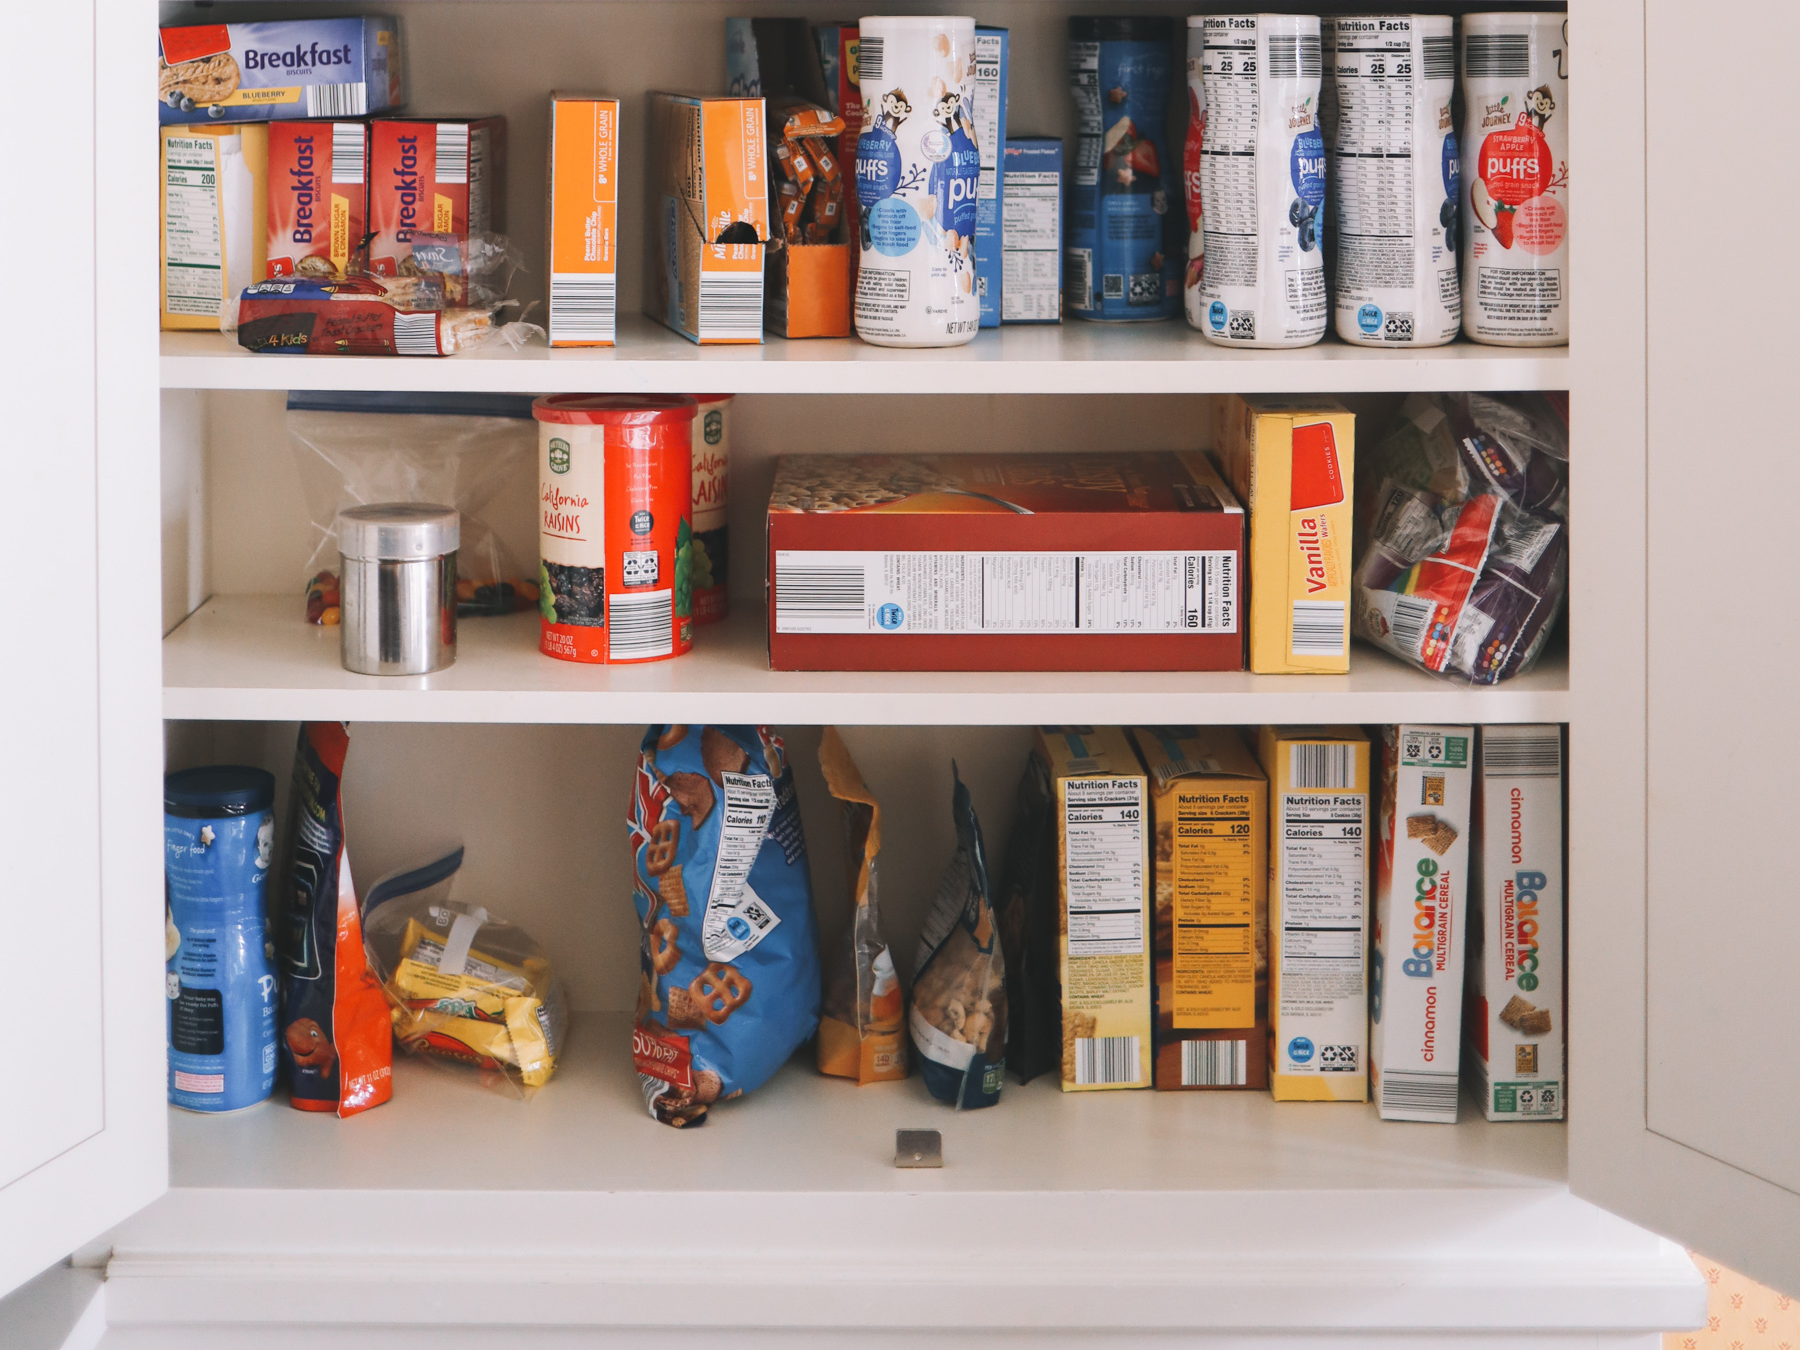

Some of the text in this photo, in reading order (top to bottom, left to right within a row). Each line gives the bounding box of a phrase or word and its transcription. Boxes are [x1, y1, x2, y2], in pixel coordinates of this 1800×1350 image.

[1229, 18, 1256, 29] Facts
[1338, 21, 1411, 31] Nutrition Facts
[977, 37, 1000, 46] Facts
[245, 42, 352, 70] Breakfast
[977, 67, 998, 78] 160
[1221, 61, 1233, 72] 25
[1243, 62, 1257, 72] 25
[1371, 64, 1385, 74] 25
[1397, 64, 1412, 74] 25
[243, 90, 286, 100] BLUEBERRY
[1486, 103, 1505, 116] little
[1482, 113, 1511, 128] JOURNEY
[168, 139, 213, 150] Nutrition Facts
[599, 110, 608, 172] WHOLE GRAIN
[746, 107, 756, 169] WHOLE GRAIN
[1493, 134, 1536, 144] STRAWBERRY
[1501, 143, 1524, 151] APPLE
[856, 159, 888, 181] puffs
[1488, 158, 1540, 180] puffs
[168, 174, 216, 185] Calories 200
[290, 135, 315, 244] Breakfast
[393, 135, 418, 244] Breakfast
[269, 333, 308, 346] 4 Kids
[1325, 446, 1335, 480] COOKIES
[541, 482, 589, 511] California
[544, 510, 580, 535] RAISINS
[1320, 514, 1329, 539] Wafers
[1298, 517, 1327, 594] Vanilla
[1188, 556, 1198, 628] Calories 160
[1222, 556, 1232, 627] Nutrition Facts
[891, 608, 899, 625] Twice
[726, 776, 772, 788] Nutrition Facts
[1068, 780, 1138, 790] Nutrition Facts
[1178, 795, 1249, 803] Nutrition Facts
[1286, 797, 1362, 806] Nutrition Facts
[727, 815, 767, 825] Calories 110
[1068, 810, 1140, 821] Calories 140
[1178, 824, 1250, 835] Calories 120
[1286, 827, 1362, 837] Calories 140
[1510, 787, 1524, 865] cinnamon
[167, 839, 206, 859] finger food
[1402, 857, 1439, 979] Balance
[1436, 870, 1450, 971] MULTIGRAIN CEREAL
[1504, 879, 1516, 981] MULTIGRAIN CEREAL
[1516, 870, 1548, 992] Balance
[1421, 986, 1437, 1063] cinnamon
